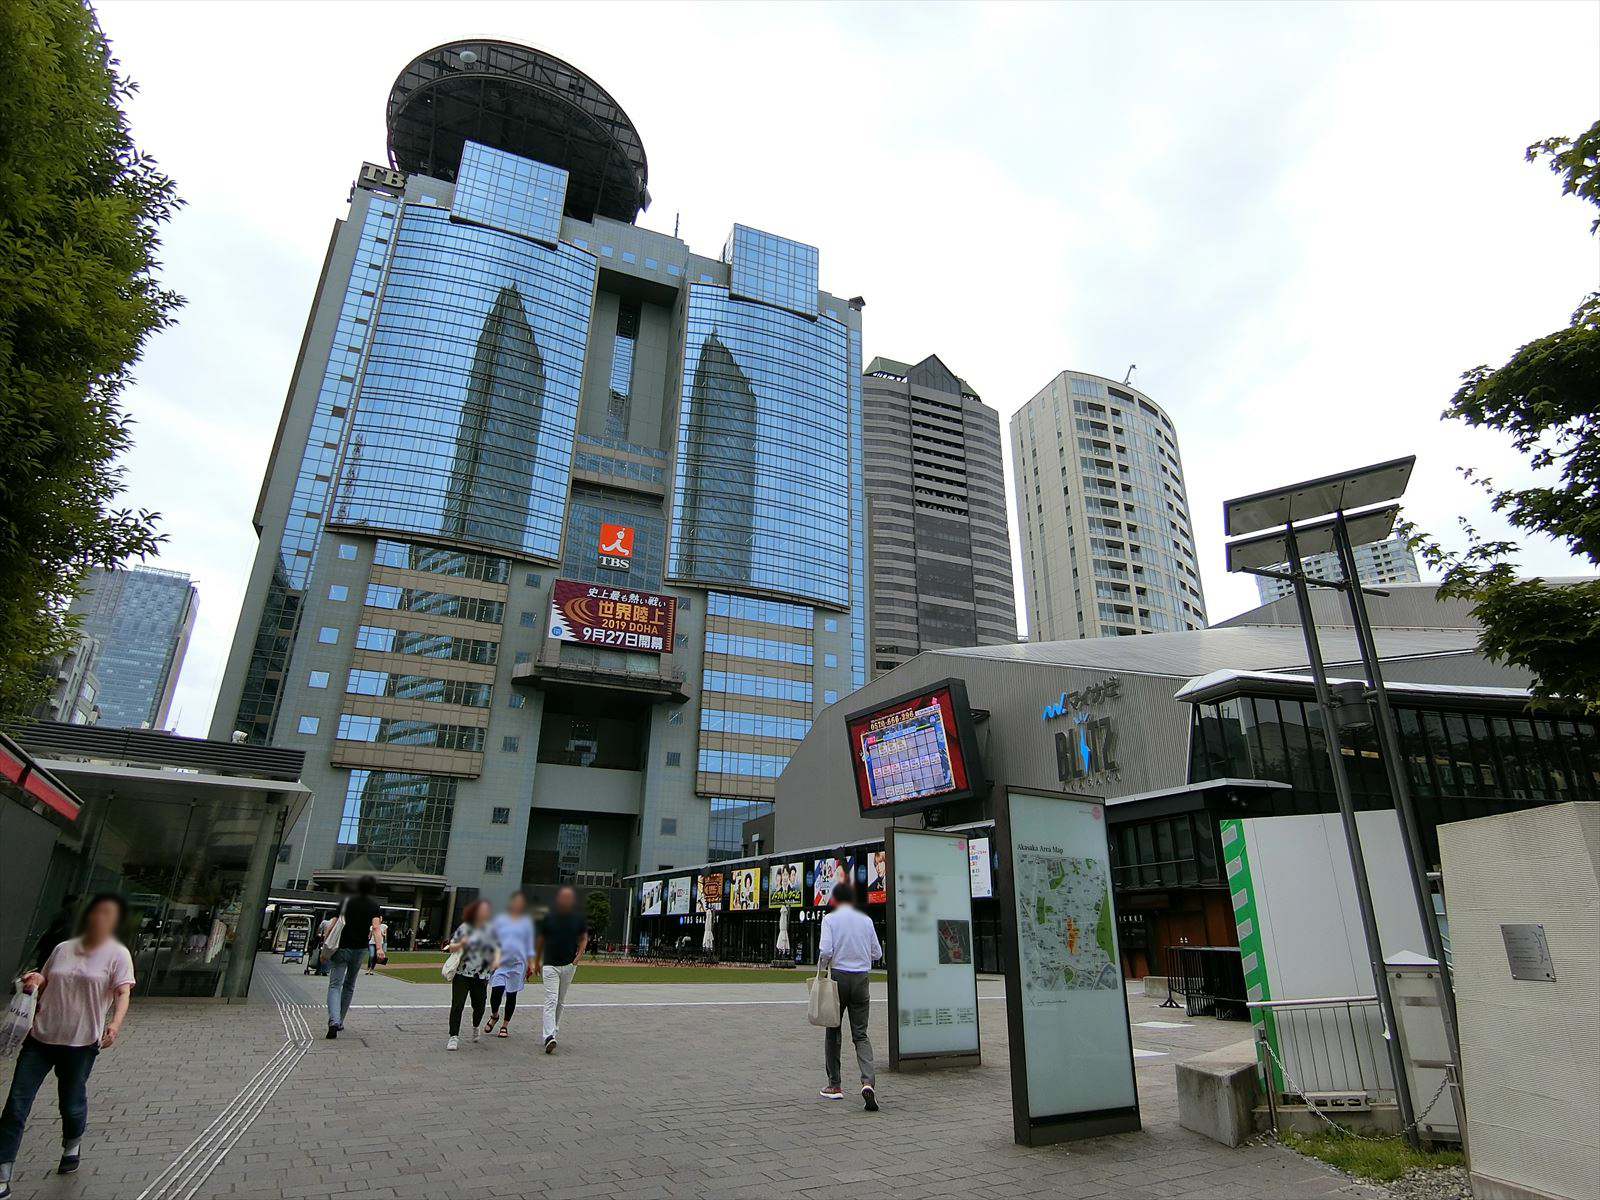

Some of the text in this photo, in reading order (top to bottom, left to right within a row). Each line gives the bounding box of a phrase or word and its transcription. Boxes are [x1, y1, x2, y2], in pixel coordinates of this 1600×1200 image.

[599, 556, 630, 569] TBS
[586, 587, 667, 608] 史上最も熱い戦い
[598, 600, 665, 626] 世界陸上
[602, 618, 659, 635] 2019 DOHA
[582, 627, 664, 651] 9月27日開幕
[1055, 713, 1117, 782] BLITZ
[1062, 769, 1120, 792] AKASAKA
[1017, 843, 1064, 855] Akasaka Area Map
[1119, 914, 1143, 922] ICKET
